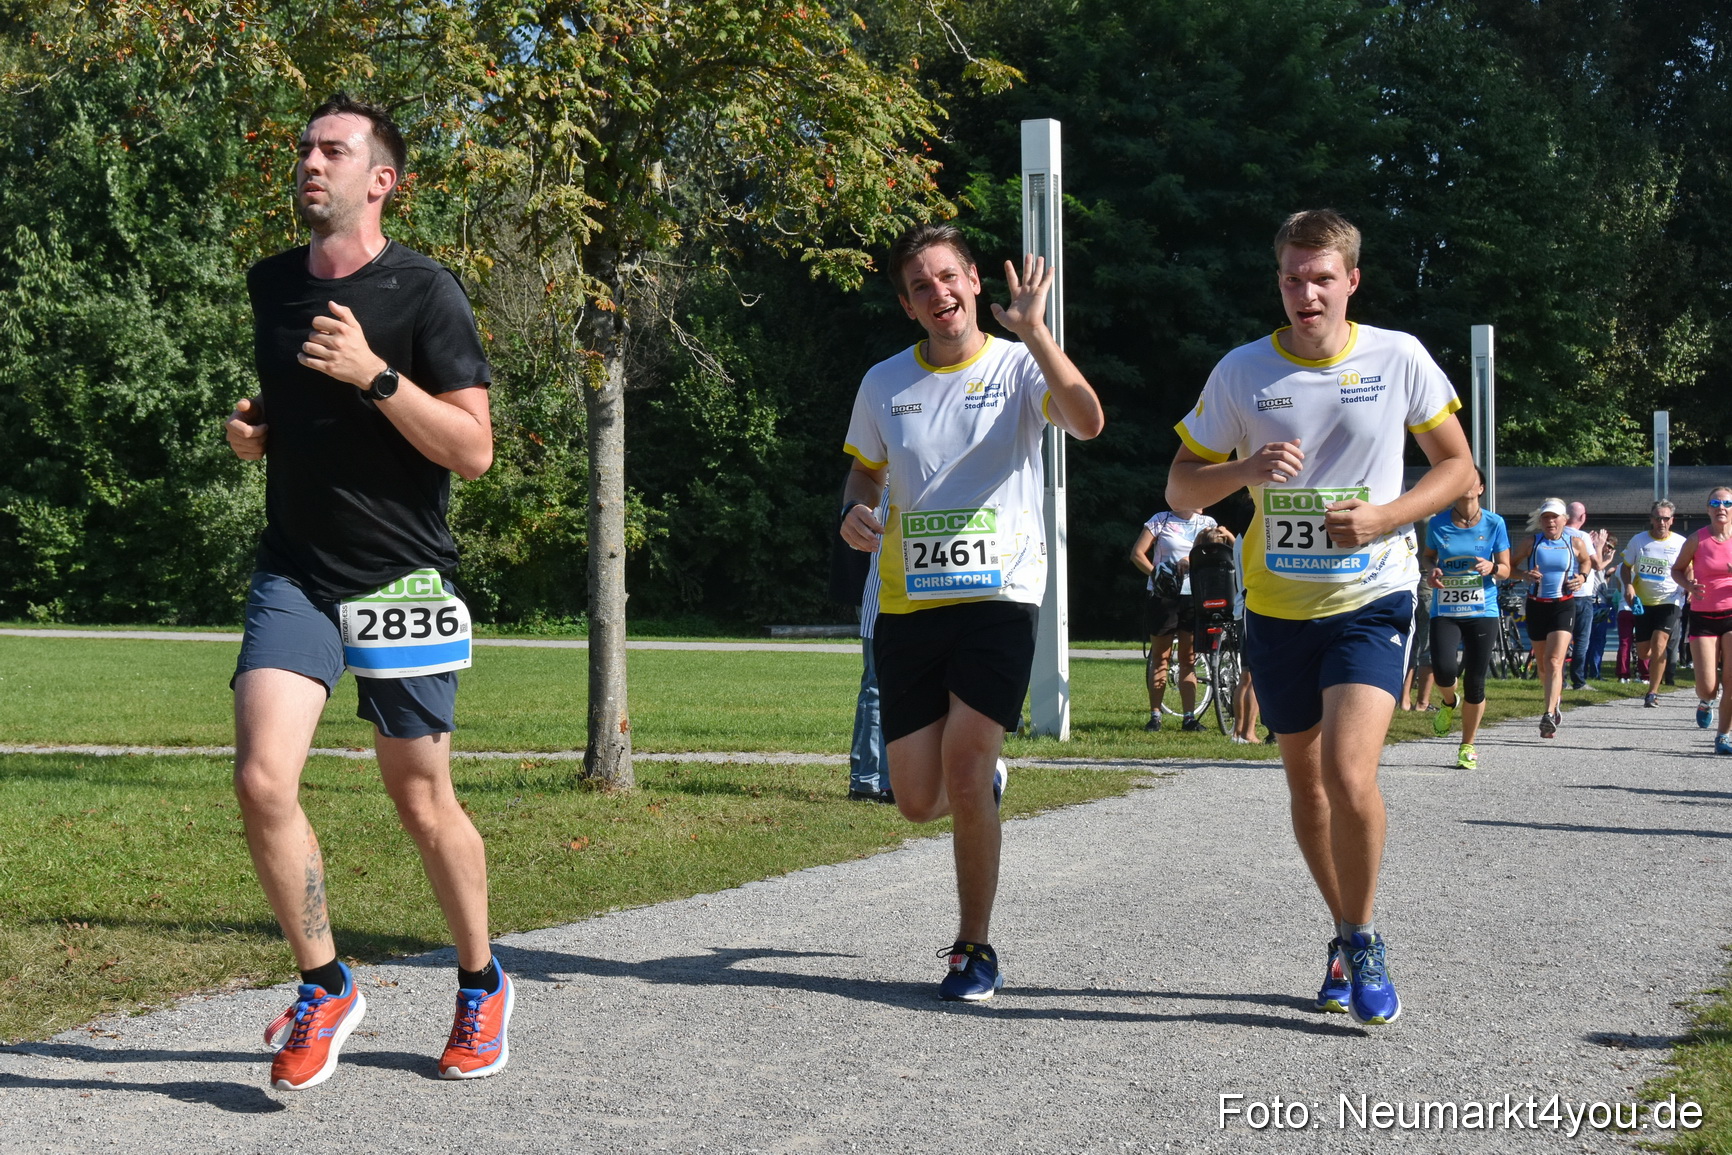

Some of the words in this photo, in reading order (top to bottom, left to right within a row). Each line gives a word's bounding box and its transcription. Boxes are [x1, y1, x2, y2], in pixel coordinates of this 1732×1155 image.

[1340, 373, 1360, 386] 20
[966, 382, 984, 394] 20
[1340, 385, 1387, 395] Neumarkter
[965, 391, 1006, 402] Neumarkter
[1340, 394, 1378, 405] Stadtlauf
[892, 403, 922, 414] BOCK
[965, 400, 998, 410] Stadtlauf
[1258, 397, 1292, 409] BOCK
[908, 511, 990, 535] BOCK
[1277, 520, 1338, 549] 231
[913, 539, 986, 569] 2461
[1275, 557, 1361, 569] ALEXANDER
[1640, 565, 1664, 575] 2706
[374, 573, 443, 598] OC
[914, 574, 992, 588] CHRISTOPH
[1442, 578, 1480, 588] BOCK
[1443, 590, 1479, 603] 2364
[357, 606, 459, 641] 2836
